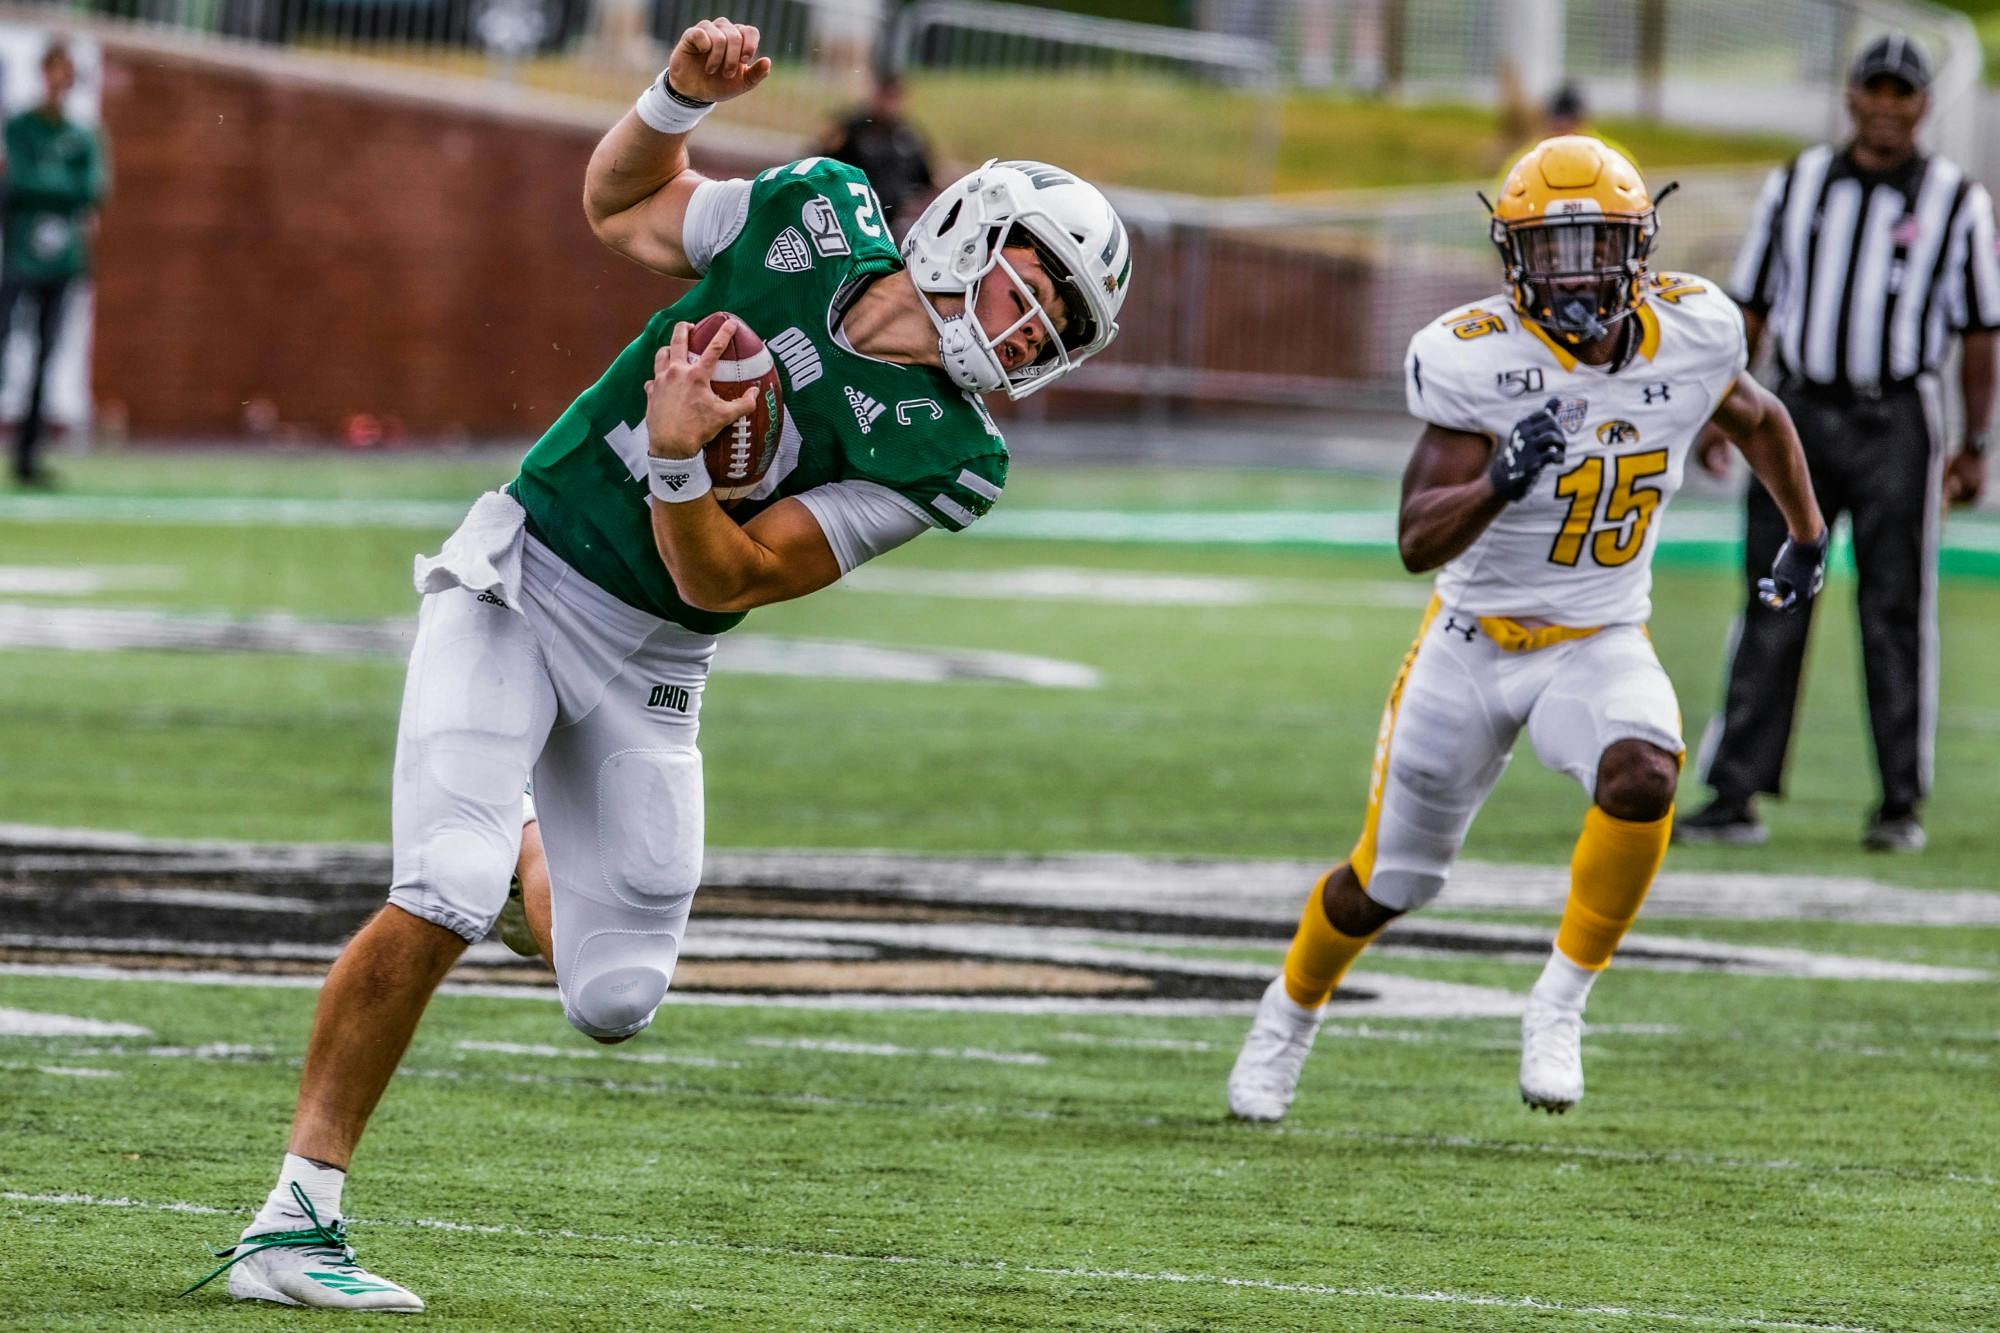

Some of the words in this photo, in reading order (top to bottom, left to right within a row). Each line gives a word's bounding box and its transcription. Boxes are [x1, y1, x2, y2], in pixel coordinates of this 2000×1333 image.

[776, 236, 801, 270] MAC
[1442, 308, 1507, 340] 15
[767, 326, 823, 392] OHIO
[1017, 367, 1041, 376] VICIS
[844, 386, 870, 434] adidas
[896, 398, 943, 426] C
[660, 473, 691, 481] adidas
[1547, 446, 1668, 567] 15
[648, 685, 689, 713] OHIO
